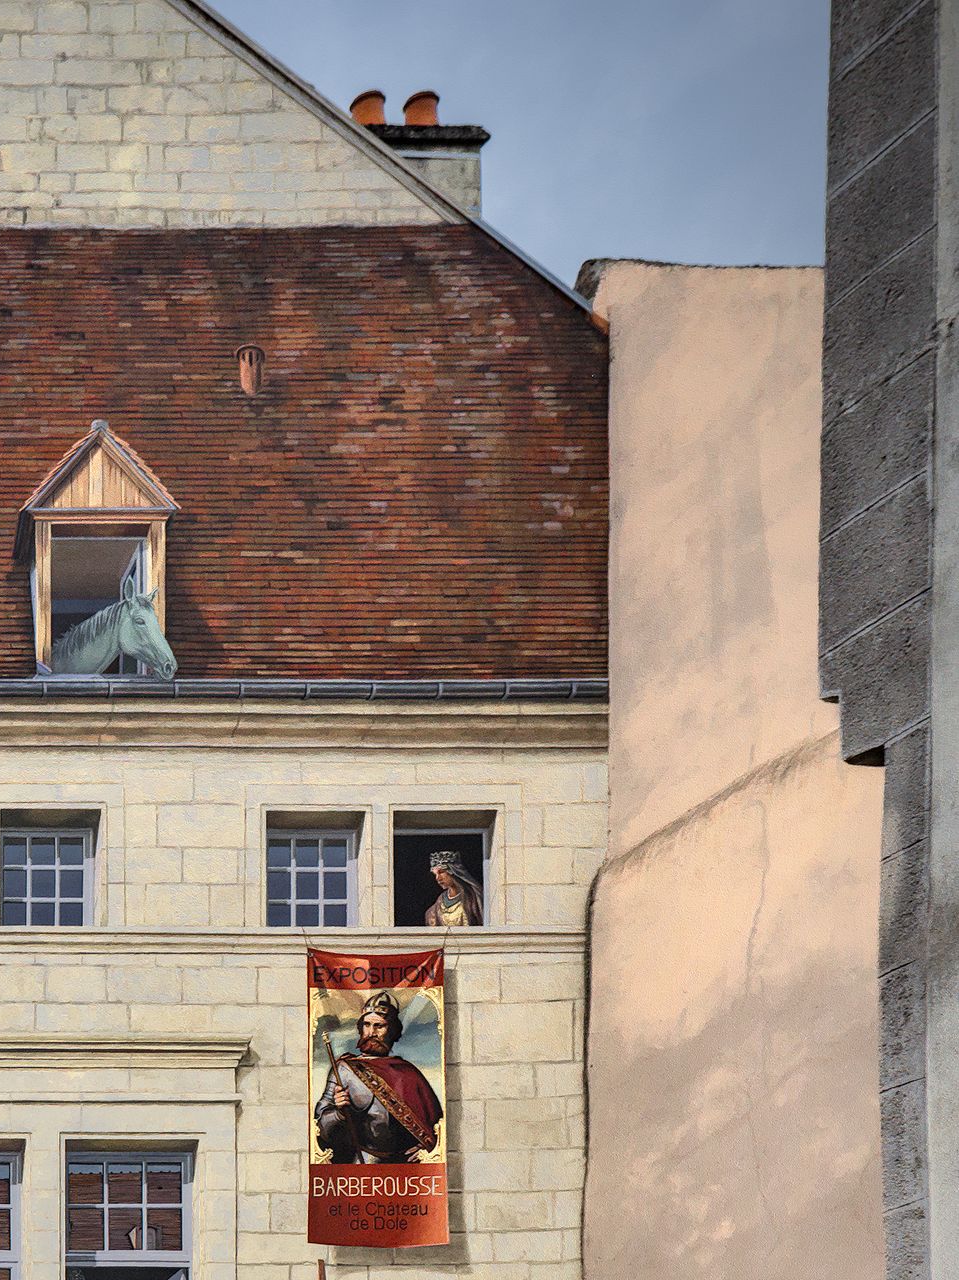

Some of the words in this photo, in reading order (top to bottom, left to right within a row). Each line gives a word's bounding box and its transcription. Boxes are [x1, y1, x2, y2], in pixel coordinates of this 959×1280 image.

[313, 965, 435, 985] EXPOSITION
[313, 1176, 443, 1197] BARBEROUSSE
[329, 1204, 342, 1216] et
[348, 1202, 360, 1216] le
[349, 1217, 369, 1230] de
[374, 1217, 408, 1230] Dole
